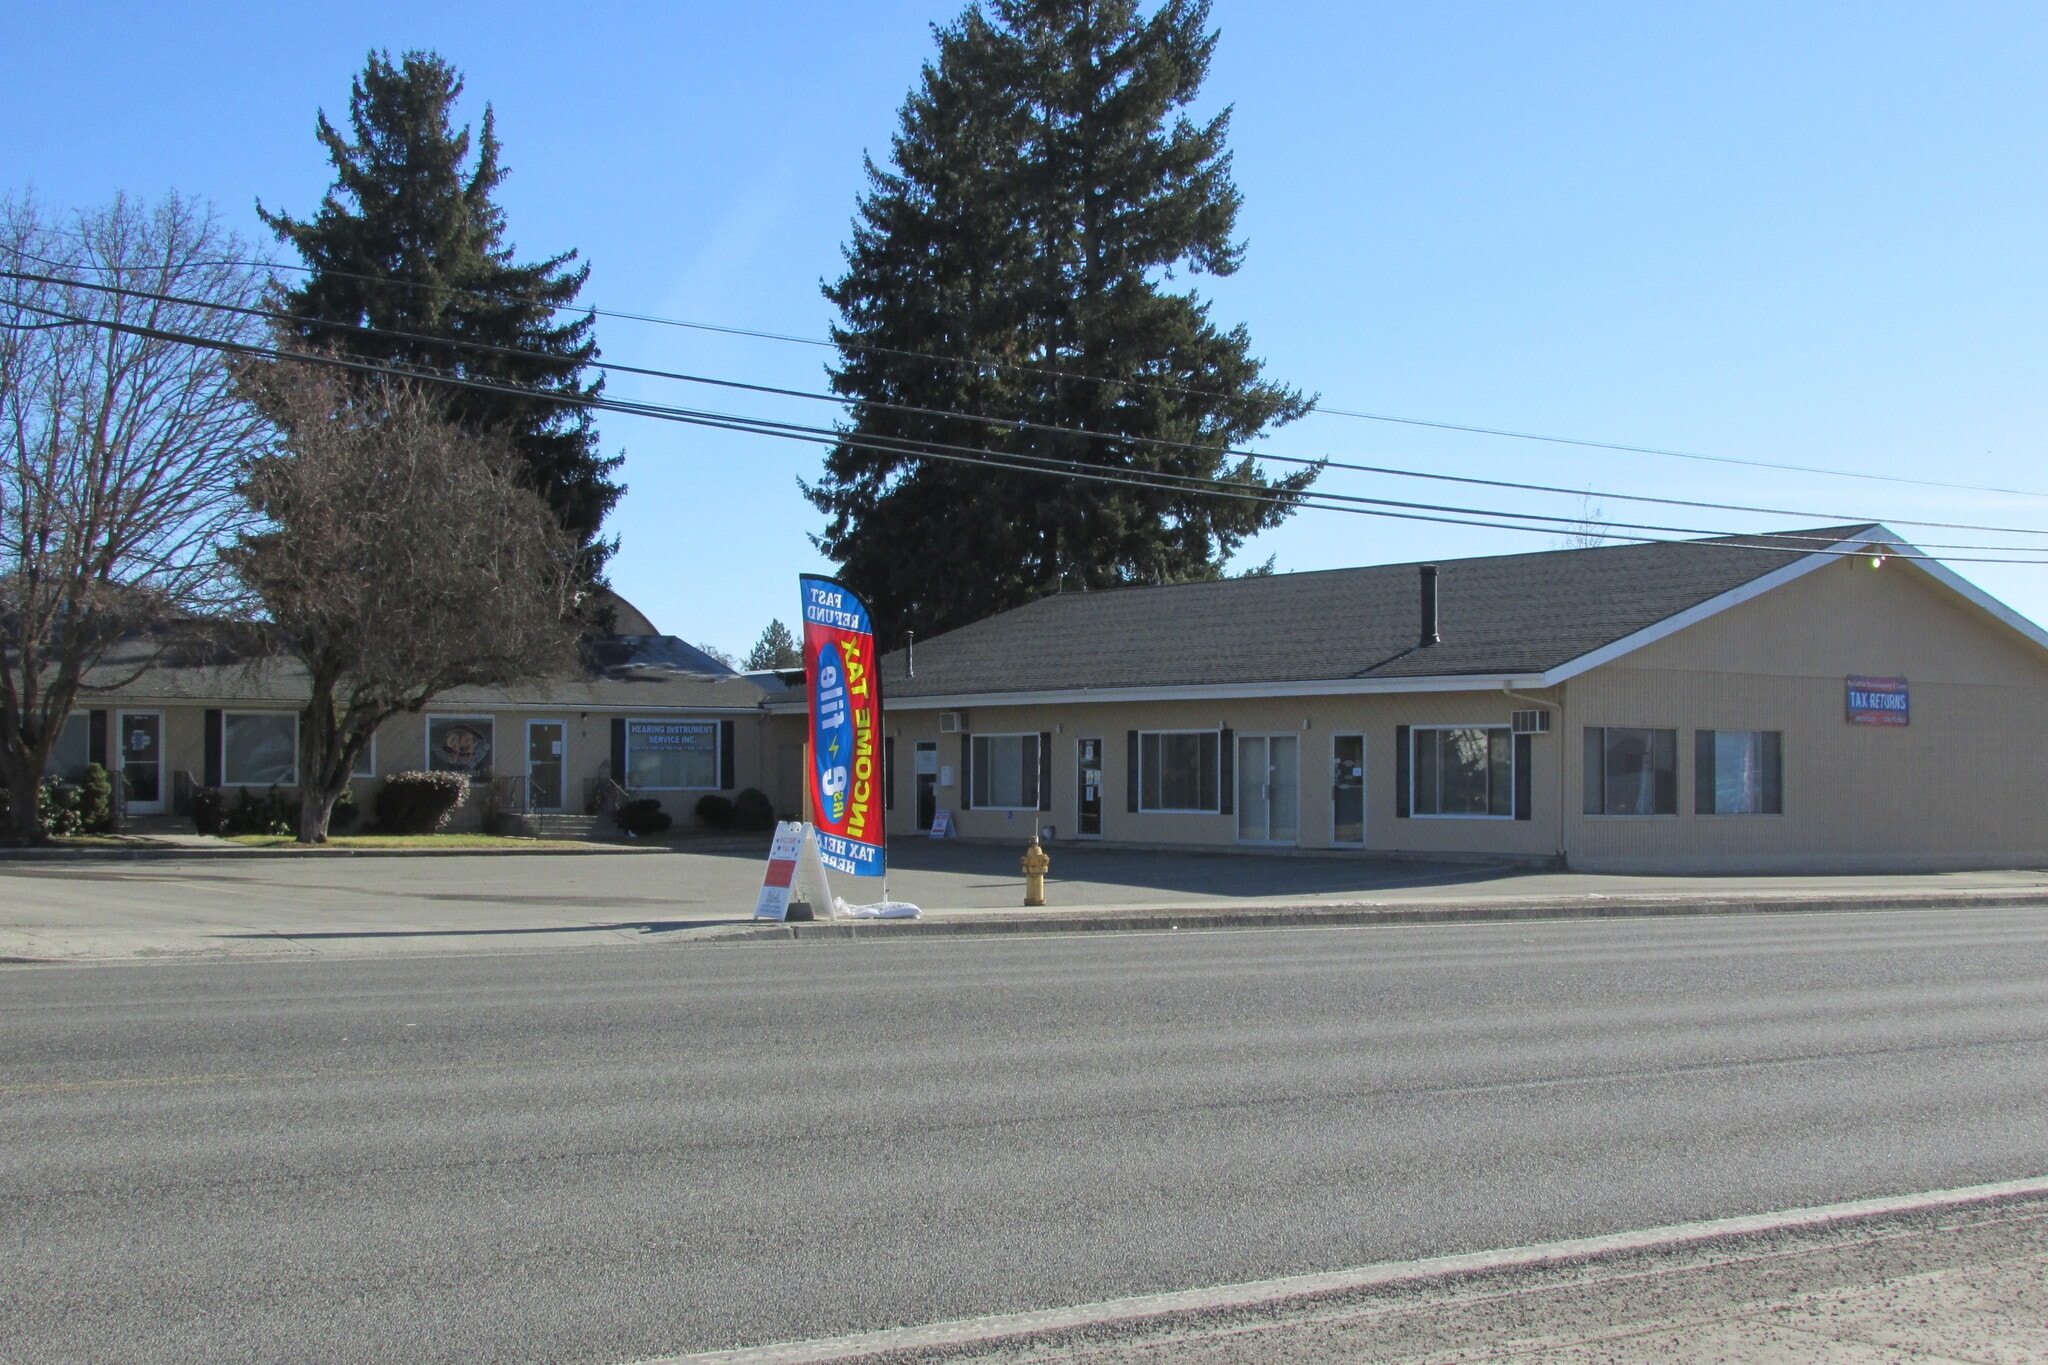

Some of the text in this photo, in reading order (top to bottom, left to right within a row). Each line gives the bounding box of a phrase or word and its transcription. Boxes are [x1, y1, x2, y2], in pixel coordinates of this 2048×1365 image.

[1850, 692, 1906, 710] TAX RETURNS
[632, 725, 713, 734] HEARING INSTRUMENT
[649, 735, 680, 744] SERVICE
